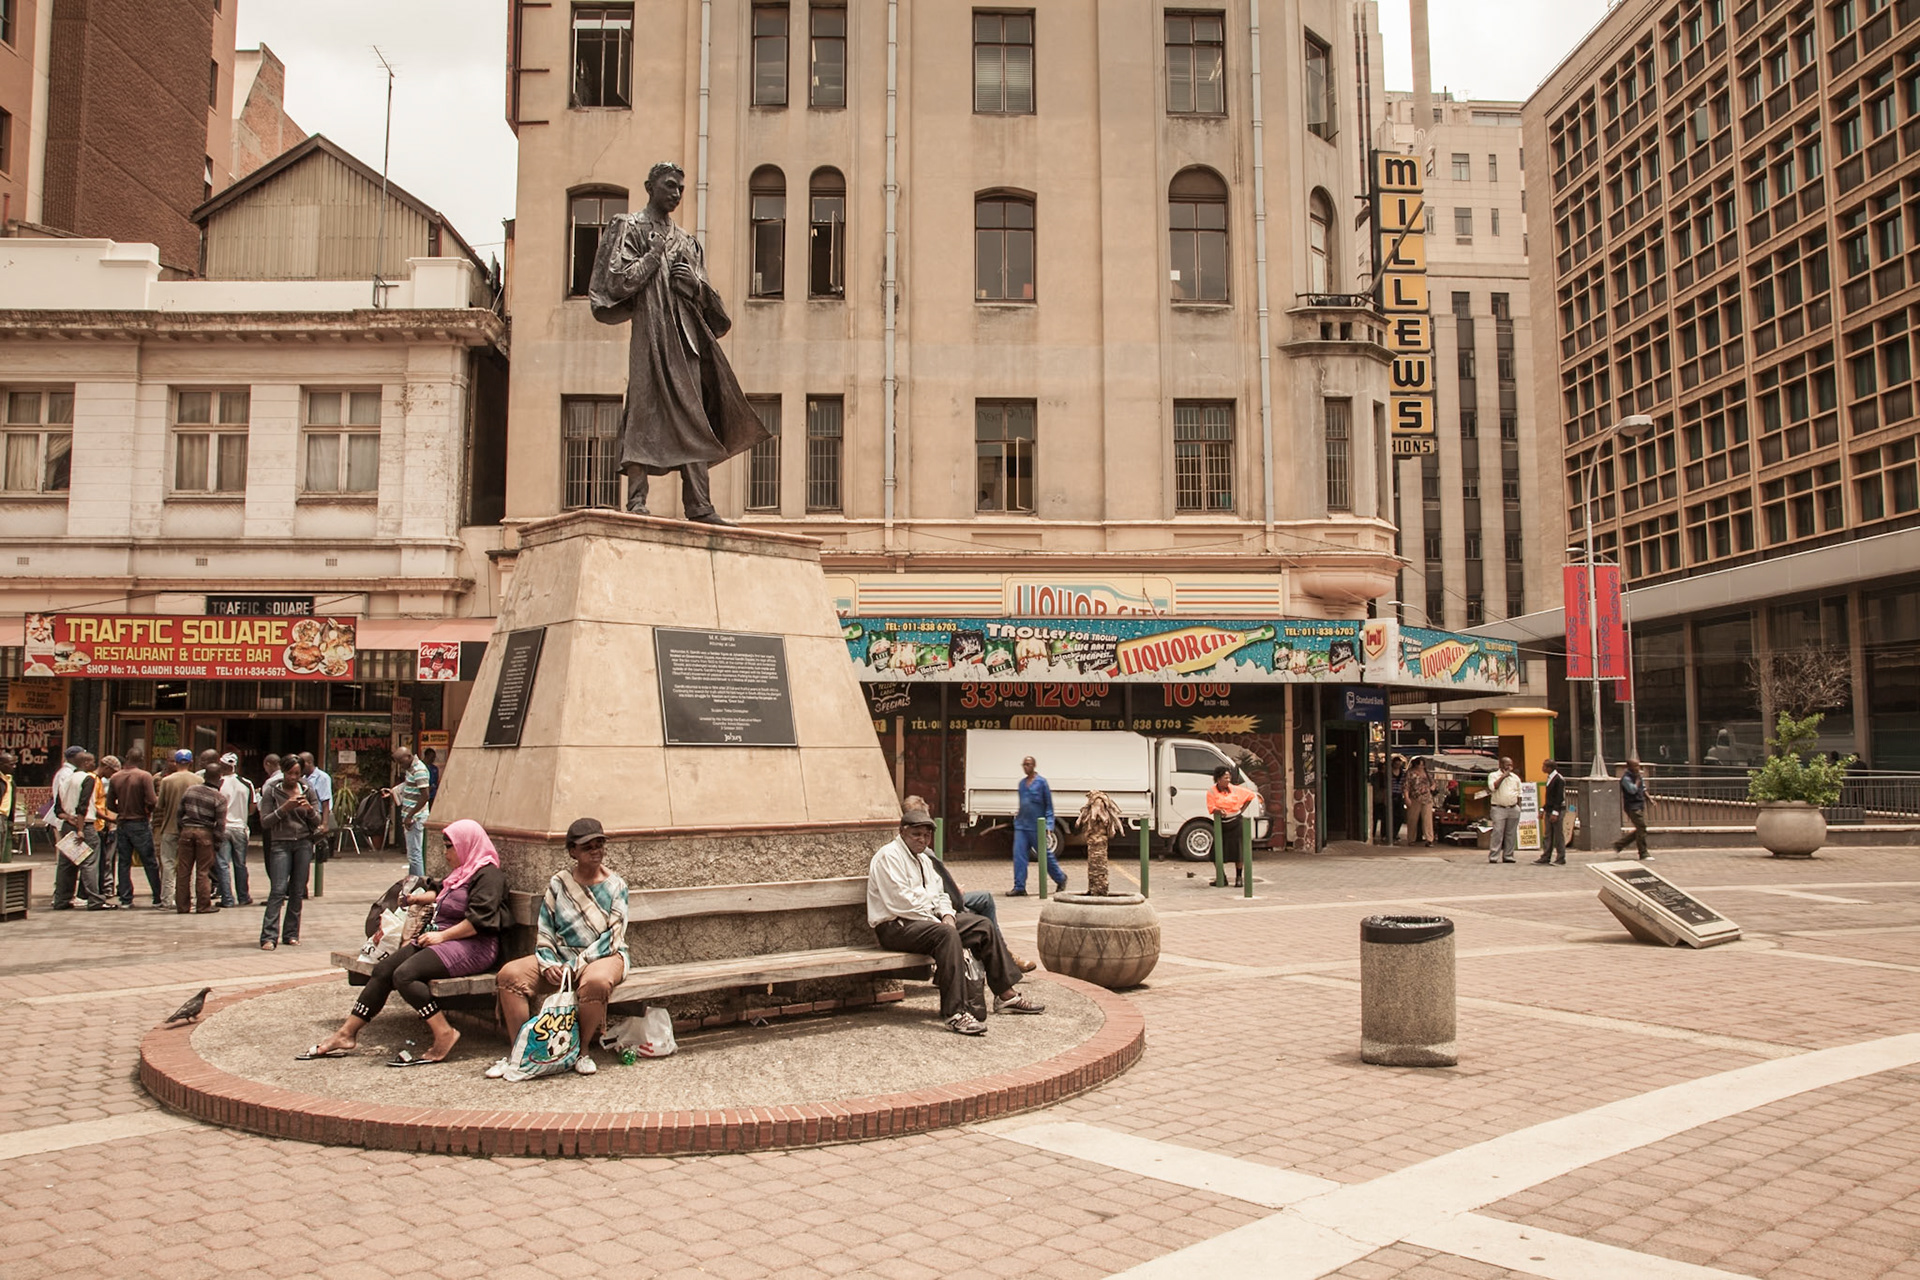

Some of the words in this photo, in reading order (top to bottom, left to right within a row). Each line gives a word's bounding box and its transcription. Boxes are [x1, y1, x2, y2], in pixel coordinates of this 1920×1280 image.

[1577, 571, 1588, 625] GANDHI
[1609, 571, 1619, 625] GANDHI
[211, 601, 260, 615] TRAFFIC
[265, 602, 310, 615] SQUARE
[65, 617, 173, 644] TRAFFIC
[182, 619, 289, 645] SQUARE
[885, 622, 900, 631] TEL:
[902, 622, 935, 631] 011-838
[937, 622, 957, 631] 6703
[986, 623, 1066, 640] TROLLEY
[1069, 631, 1090, 641] FOR
[1092, 633, 1118, 641] TROLLEY
[1285, 627, 1300, 636] TEL:
[1301, 627, 1334, 636] 011-838
[1335, 627, 1355, 636] 6703
[1074, 643, 1089, 651] WE
[1090, 643, 1104, 651] ARE
[1568, 616, 1579, 672] SQUARE
[1600, 615, 1611, 671] SQUARE
[94, 646, 175, 661] RESTAURANT
[179, 647, 188, 661] &
[192, 648, 242, 662] COFFEE
[246, 648, 271, 662] BAR
[1122, 634, 1202, 676] LIQUOR
[1200, 633, 1239, 655] CITY
[86, 664, 109, 674] SHOP
[111, 665, 124, 674] No:
[126, 665, 139, 676] 7A,
[141, 665, 172, 675] GANDHI
[174, 666, 207, 675] SQUARE
[215, 666, 233, 676] TEL:
[234, 666, 287, 676] 011-834-5675
[1421, 646, 1452, 680] LIQUOR
[1451, 646, 1466, 663] CITY
[874, 697, 911, 713] SPECIALS
[1016, 716, 1059, 731] LIQUOR
[1060, 720, 1080, 731] CITY
[1155, 719, 1182, 730] 6703
[20, 747, 48, 765] Bar
